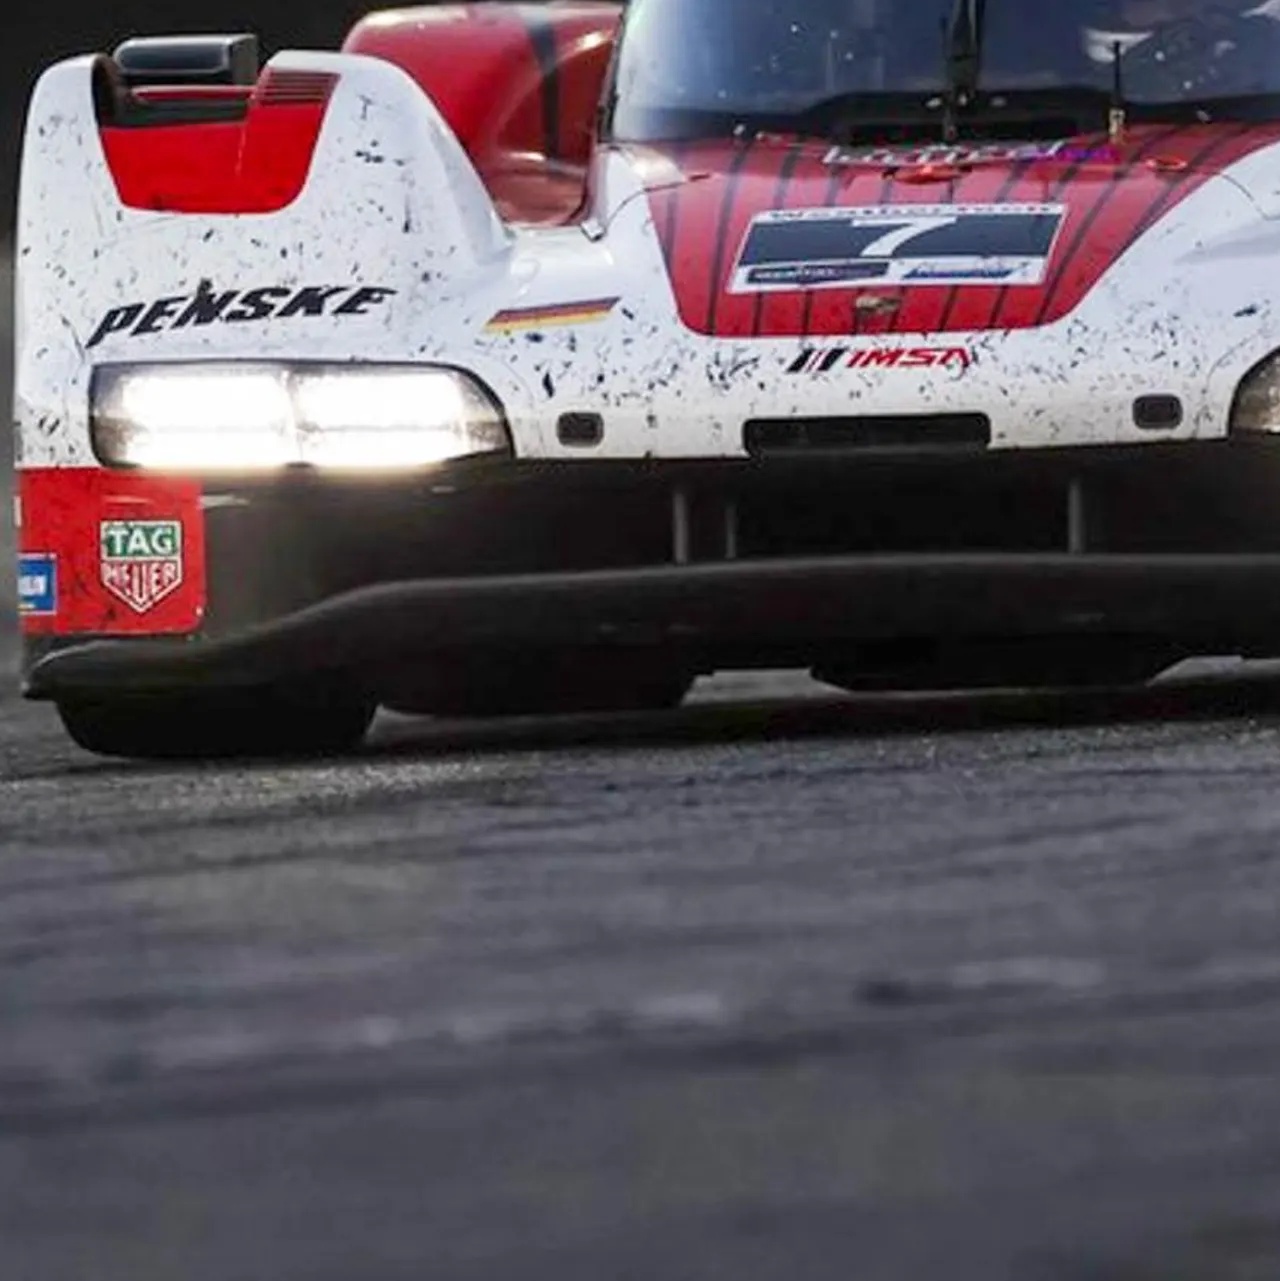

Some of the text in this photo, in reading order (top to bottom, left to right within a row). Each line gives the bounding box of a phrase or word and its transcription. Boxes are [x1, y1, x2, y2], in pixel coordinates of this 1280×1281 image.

[852, 215, 957, 258] 7
[85, 286, 398, 349] PENSKE
[846, 347, 975, 368] IMSA
[107, 527, 173, 554] TAG
[101, 561, 177, 603] HEUER
